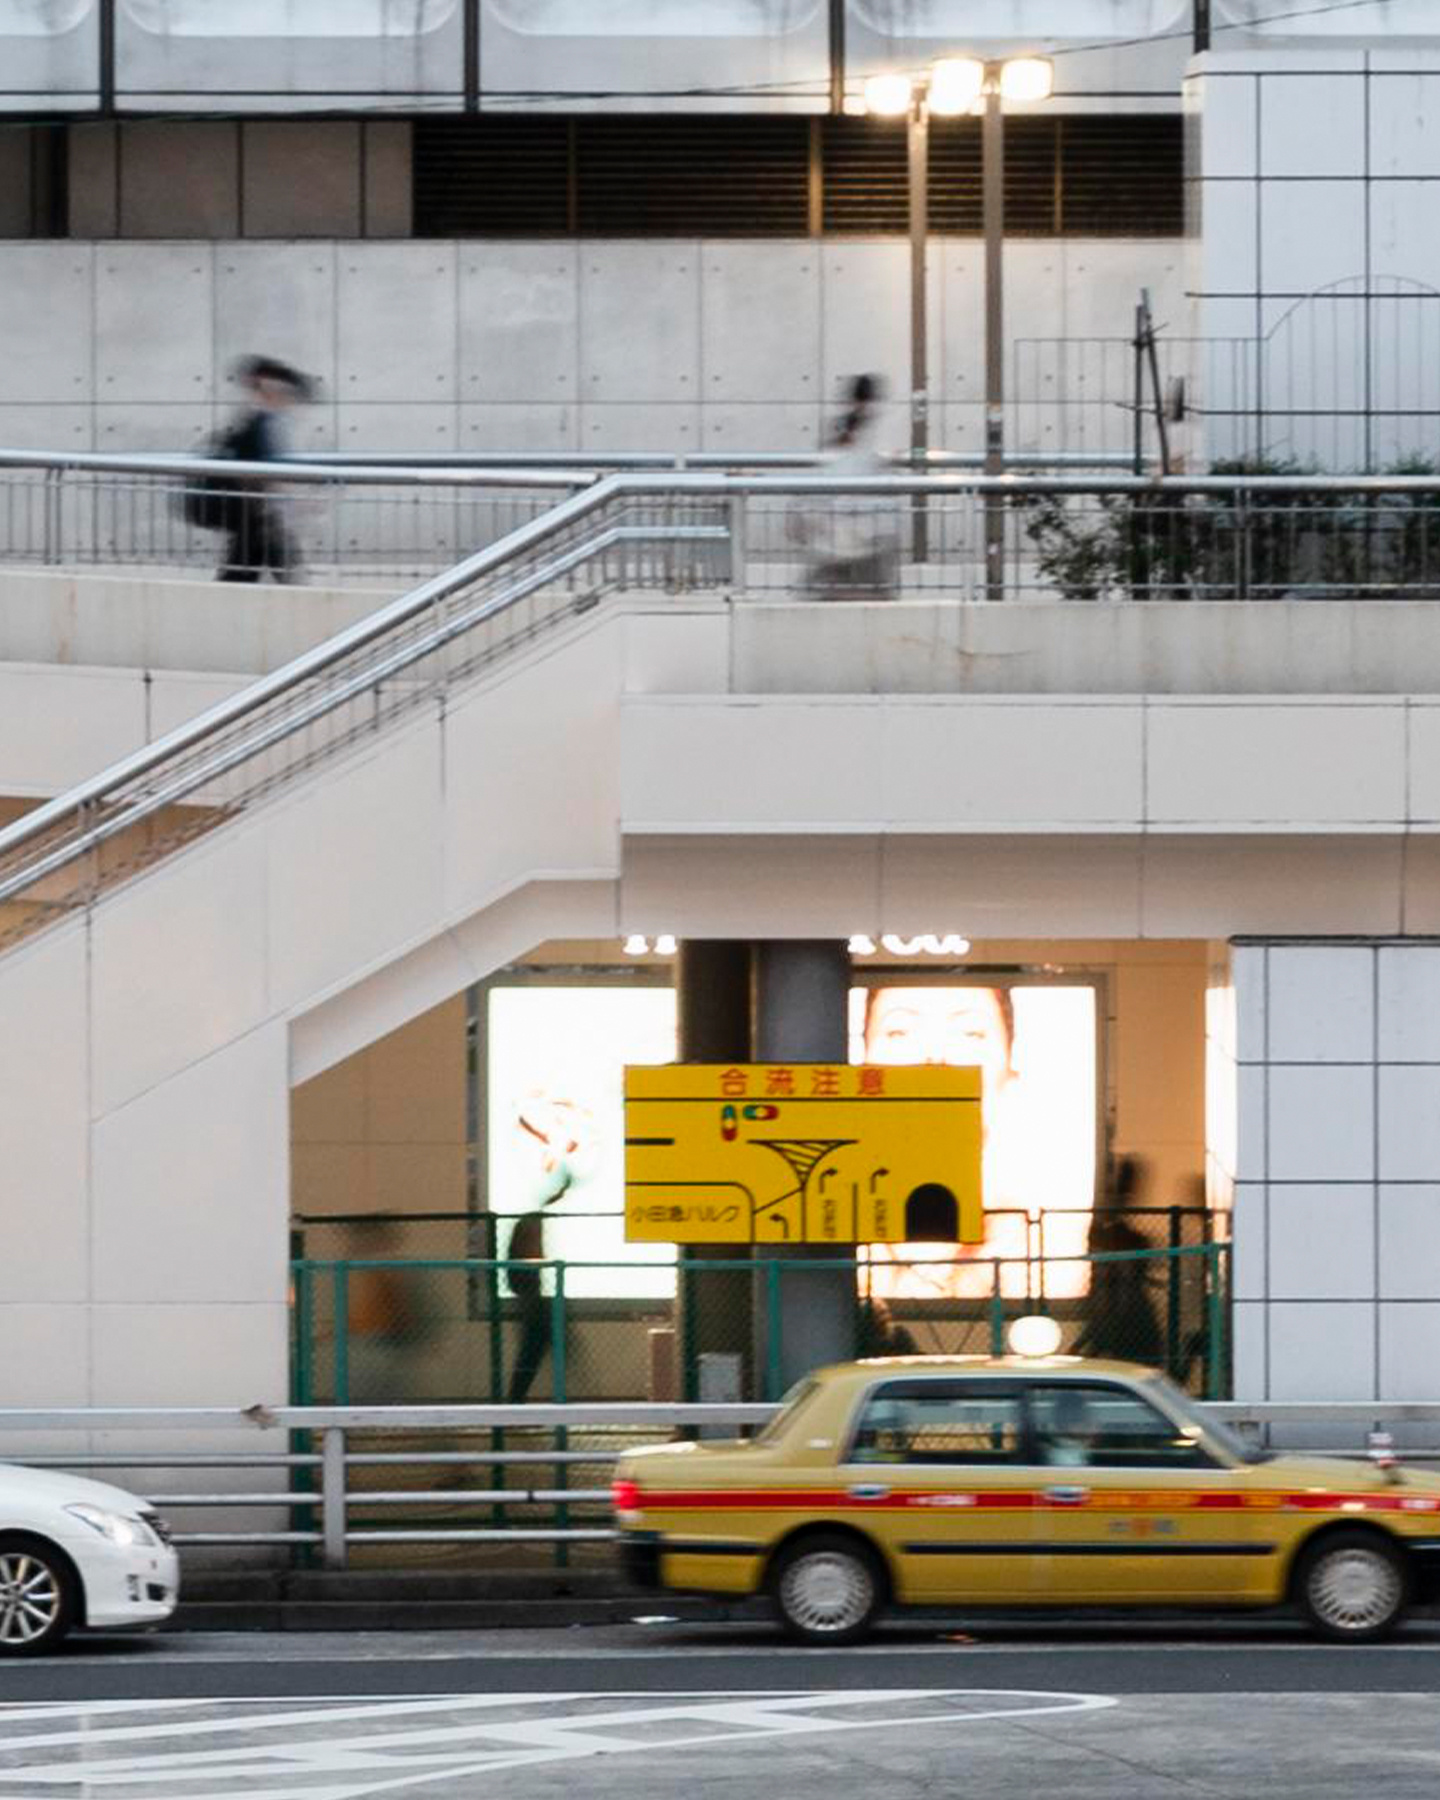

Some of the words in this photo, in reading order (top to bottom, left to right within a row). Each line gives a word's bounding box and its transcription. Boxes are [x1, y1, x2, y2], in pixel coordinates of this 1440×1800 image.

[721, 1068, 885, 1096] 合流注意
[630, 1204, 739, 1223] 小田急ハルク
